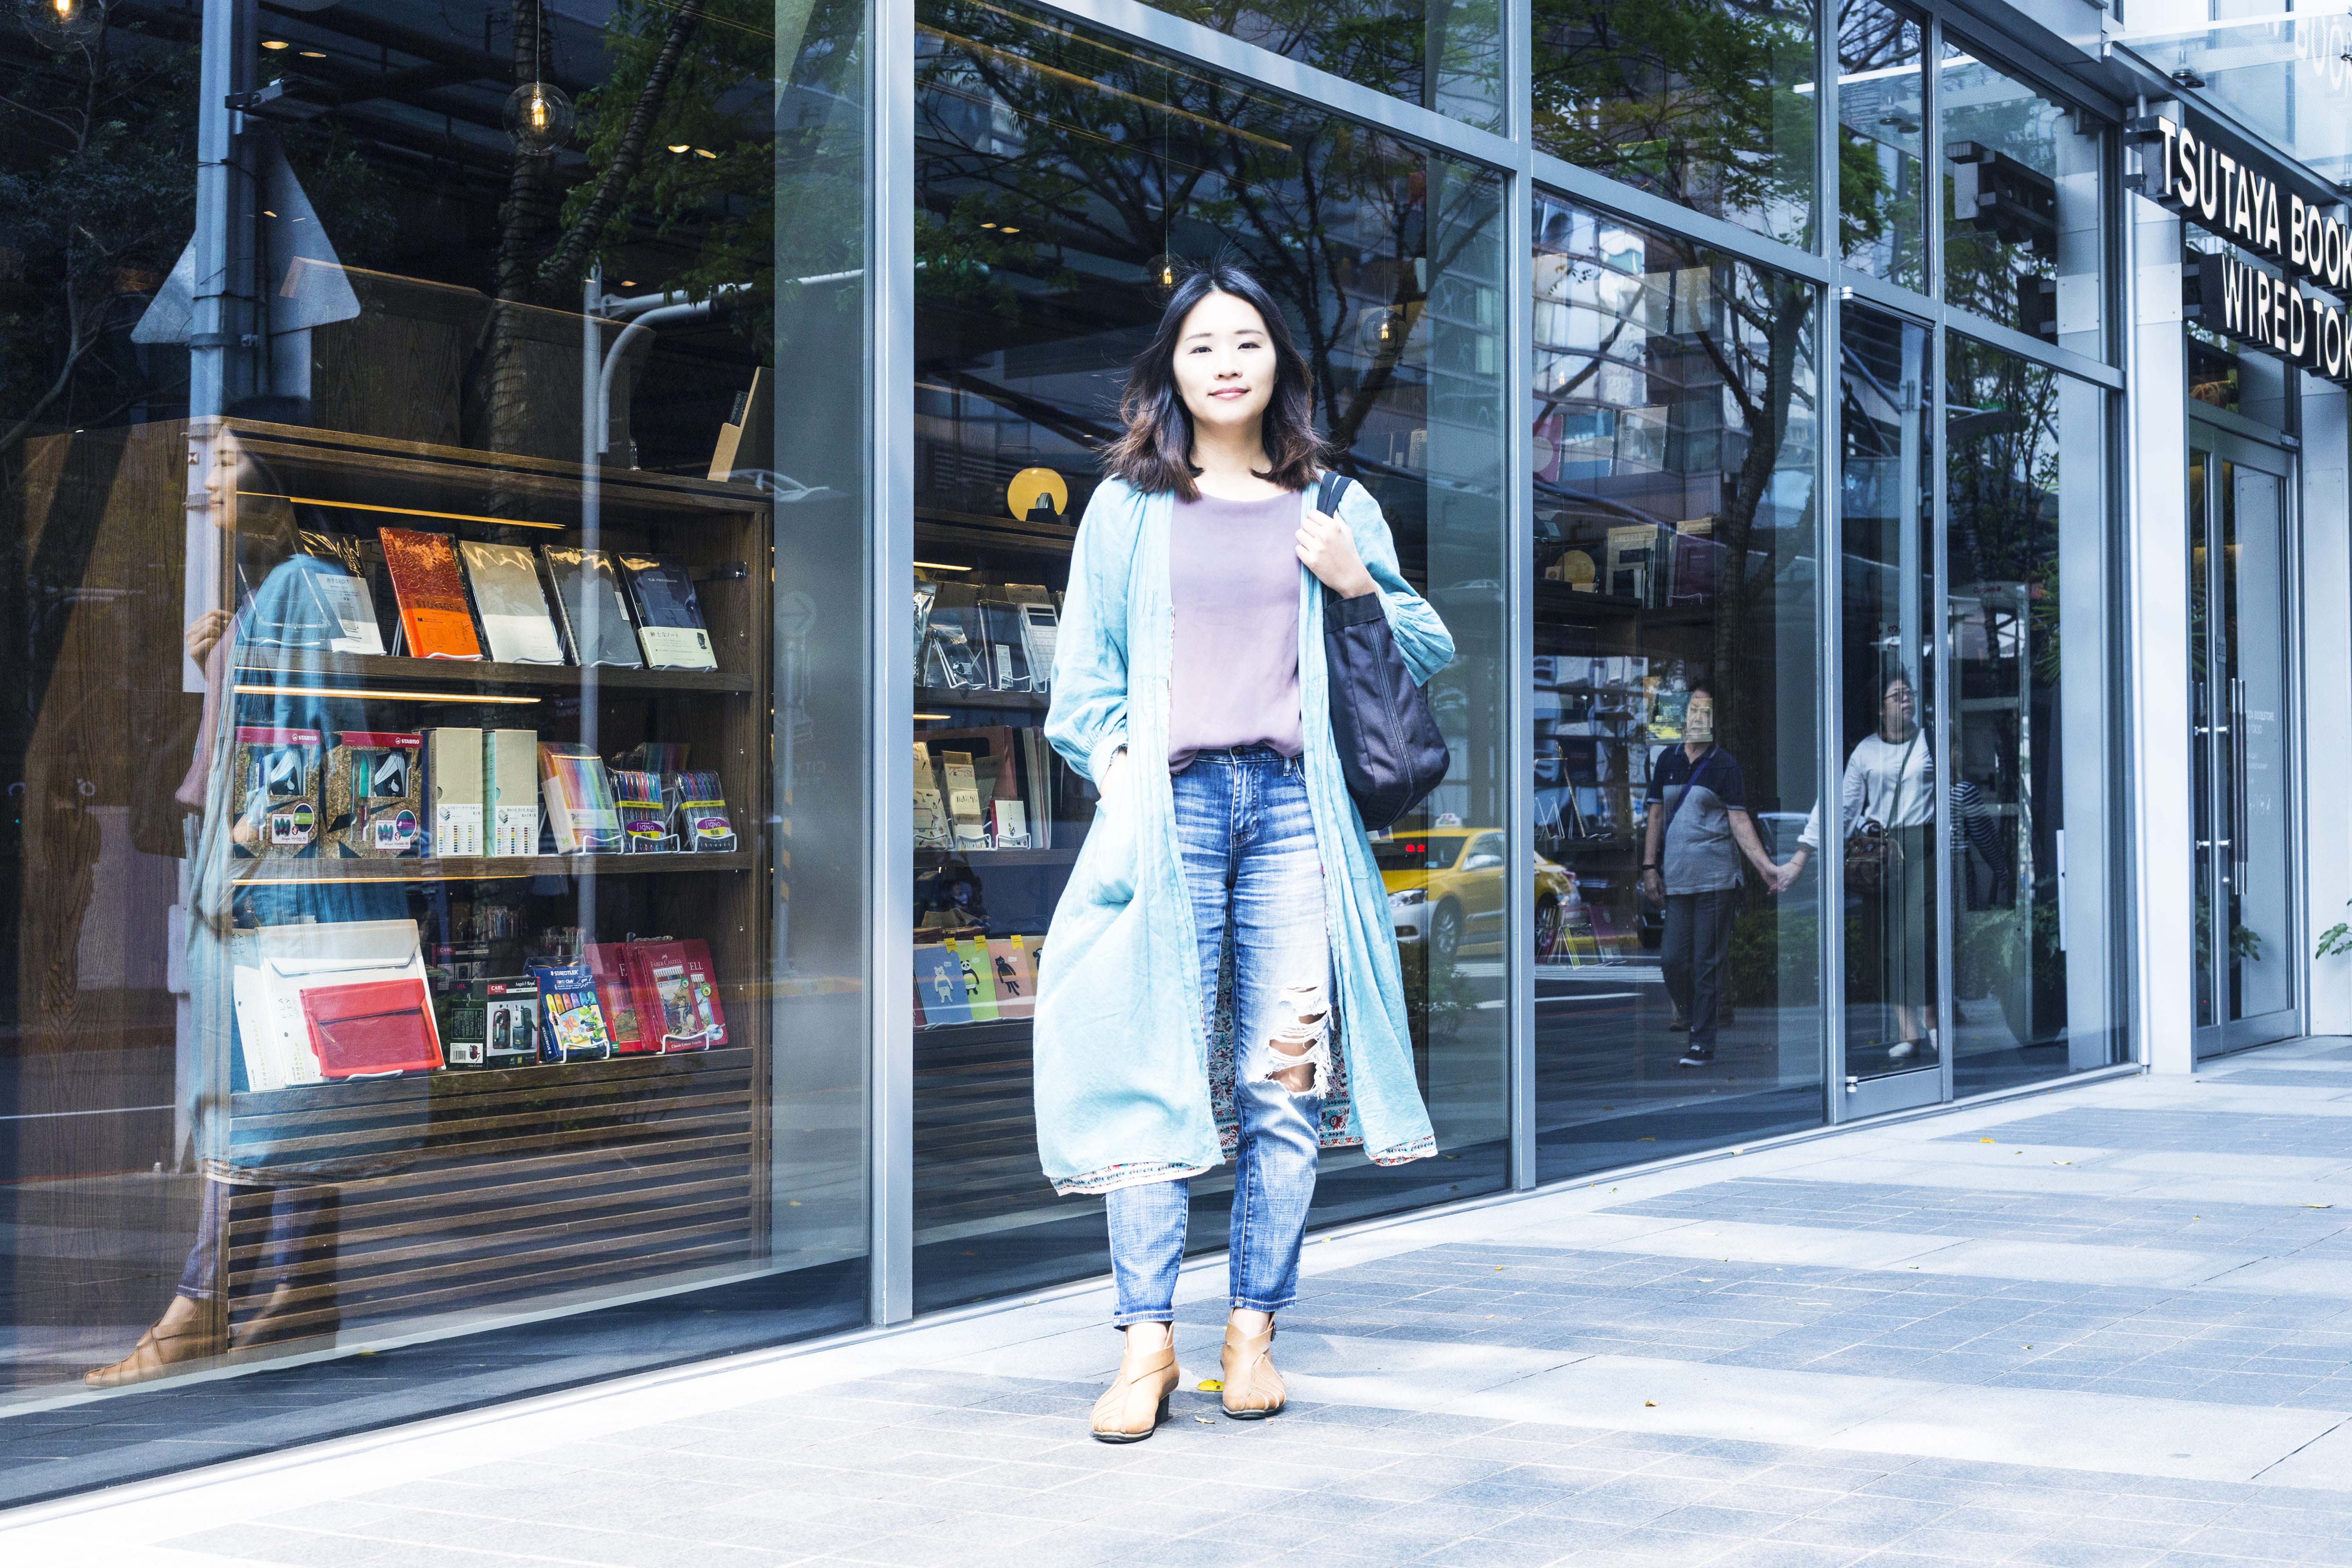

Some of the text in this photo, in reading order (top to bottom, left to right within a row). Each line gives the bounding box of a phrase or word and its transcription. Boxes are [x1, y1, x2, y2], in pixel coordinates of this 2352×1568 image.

[2158, 116, 2352, 290] TSUTAYA BOOK
[2222, 254, 2305, 356] WIRED
[542, 1026, 551, 1051] STAEDTLER
